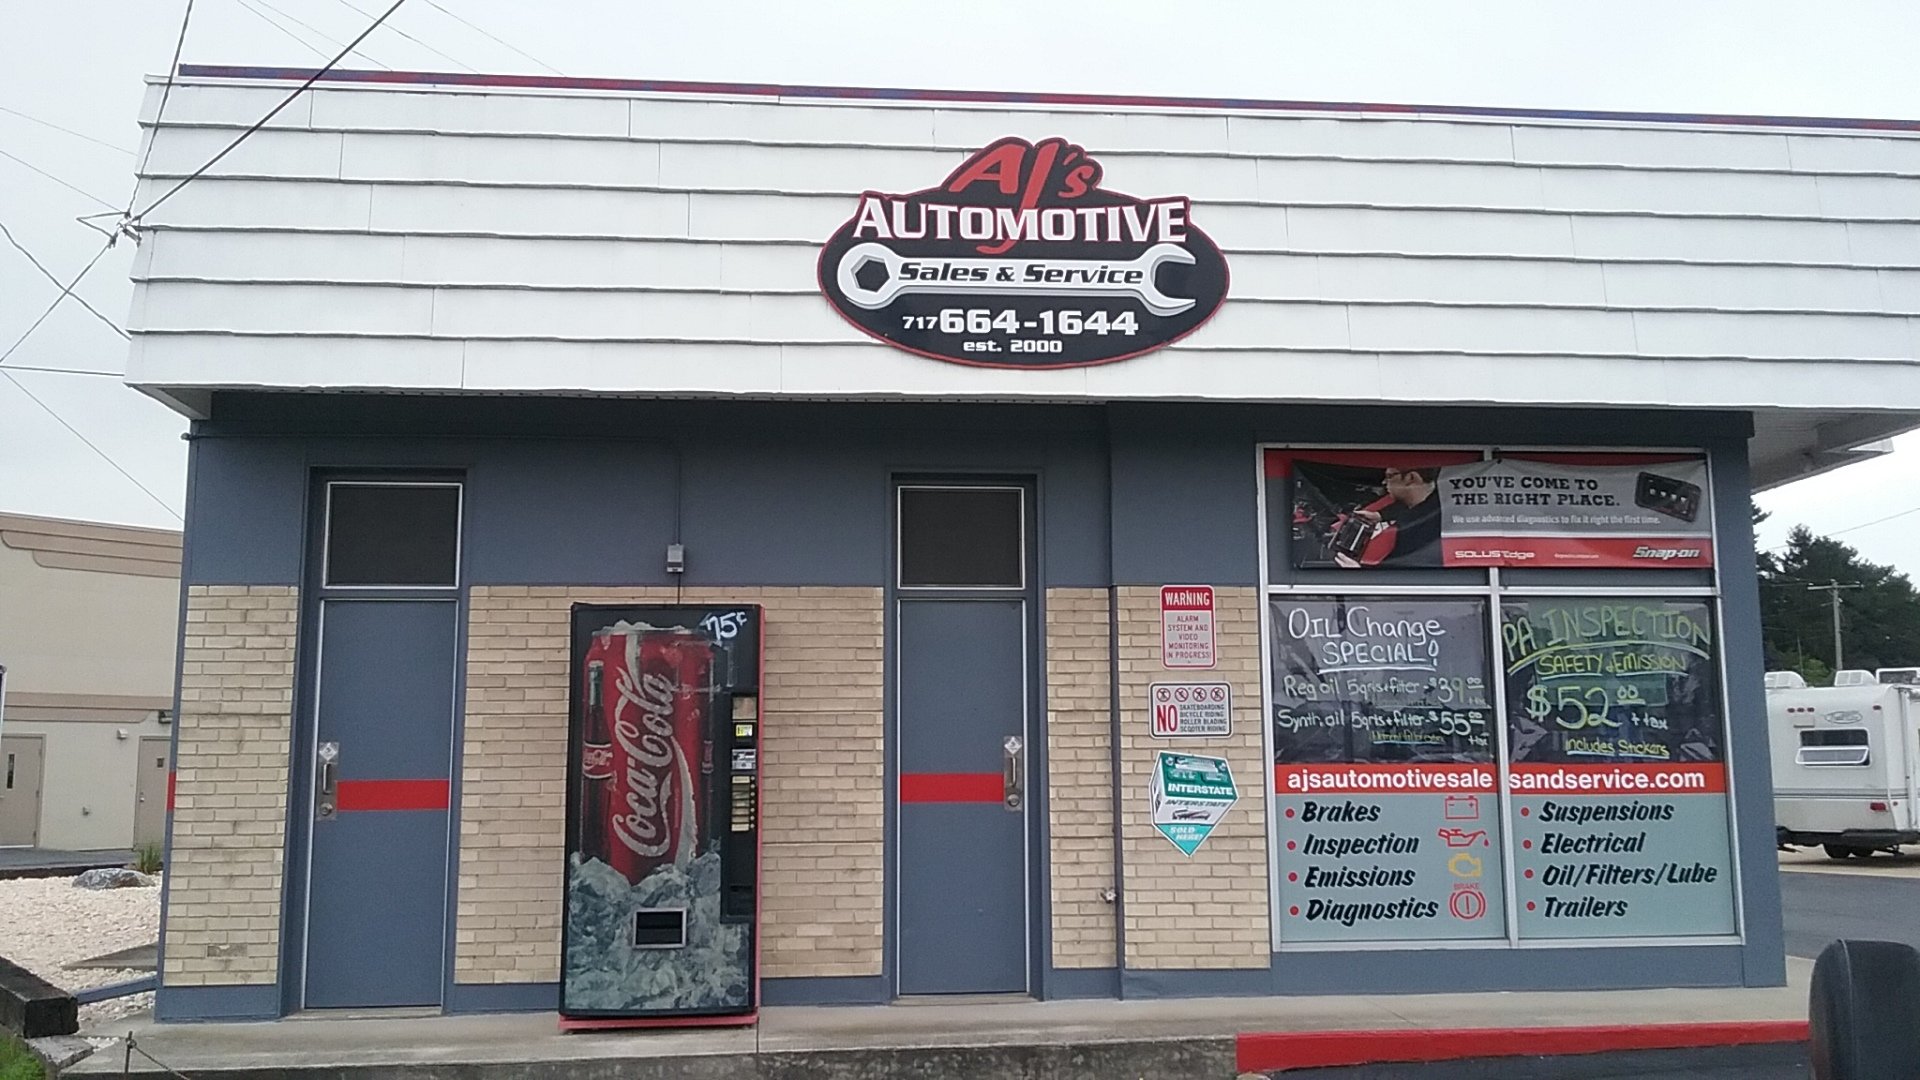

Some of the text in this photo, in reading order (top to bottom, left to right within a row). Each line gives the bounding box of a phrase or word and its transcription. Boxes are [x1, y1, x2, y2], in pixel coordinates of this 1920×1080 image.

[853, 197, 1188, 243] AUTOMOTIVE
[898, 261, 1144, 284] Sales & Service
[902, 308, 1140, 336] 717 664-1644
[963, 340, 1063, 354] est. 2000
[1449, 475, 1598, 490] YOU'VE COME TO
[1451, 493, 1620, 507] THE RIGHT PLACE.
[1452, 515, 1465, 524] We
[1466, 516, 1480, 524] use
[1481, 514, 1515, 524] advanced
[1516, 514, 1560, 525] diagnostics
[1561, 515, 1569, 524] to
[1571, 514, 1582, 524] fix
[1583, 515, 1589, 524] it
[1590, 515, 1609, 525] right
[1610, 515, 1622, 524] the
[1624, 514, 1641, 524] first
[1454, 550, 1501, 559] SOLUS
[1632, 546, 1701, 561] Snap-on
[1165, 592, 1211, 607] WARNING
[1168, 624, 1209, 632] SYSTEM AND
[1178, 633, 1198, 641] VIDEO
[1346, 606, 1446, 646] Change
[1503, 606, 1712, 662] PA INSPECTION
[1166, 651, 1173, 659] IN
[1168, 642, 1209, 650] MONITORING
[1535, 653, 1603, 675] SAFETY
[1284, 675, 1317, 701] Reg
[1319, 677, 1340, 694] oil
[1156, 705, 1178, 732] NO
[1325, 708, 1345, 727] oil
[612, 667, 674, 857] Coca-Cola
[1167, 782, 1234, 796] INTERSTATE
[1287, 768, 1706, 792] ajsautomotivesale sandservice.com
[1301, 800, 1381, 823] Brakes
[1538, 800, 1675, 825] Suspensions
[1170, 826, 1196, 834] SOLD
[1302, 832, 1420, 859] Inspection
[1541, 832, 1647, 854] Electrical
[1304, 865, 1417, 888] Emissions
[1452, 882, 1480, 890] BRAKE
[1542, 862, 1718, 888] Oil/Filters/Lube
[1305, 897, 1439, 927] Diagnostics
[1544, 896, 1629, 918] Trailers
